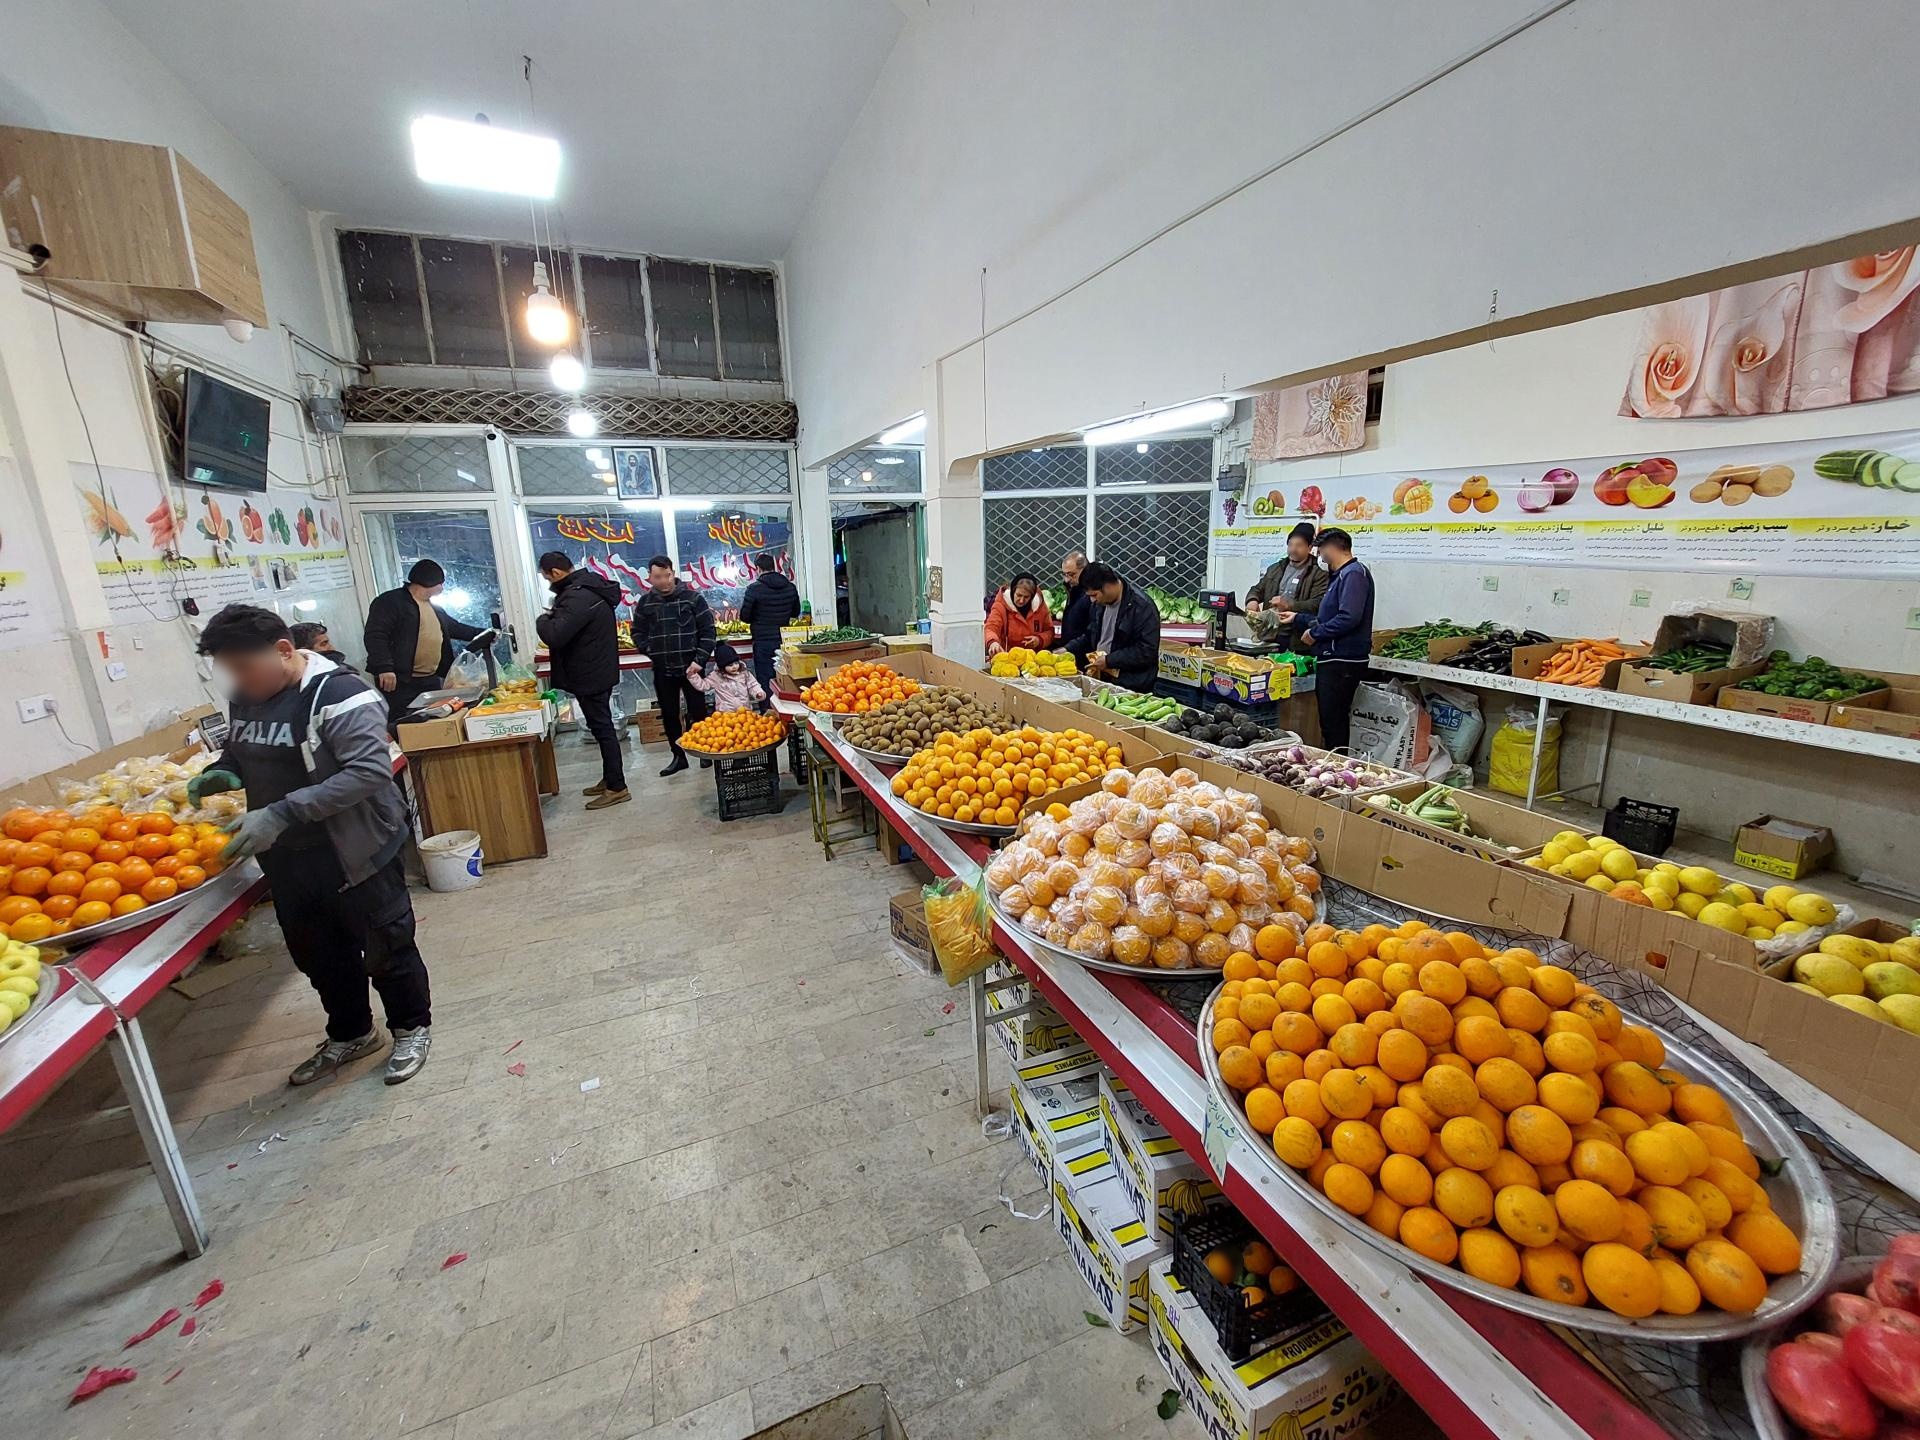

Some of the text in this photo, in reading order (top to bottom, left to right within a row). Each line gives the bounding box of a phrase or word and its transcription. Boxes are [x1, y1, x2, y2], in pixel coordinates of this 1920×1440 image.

[1762, 524, 1789, 533] سیب
[1352, 708, 1399, 728] نیک پلاست
[1282, 1330, 1323, 1360] PRODUCE
[1322, 1326, 1334, 1341] OF
[1329, 1375, 1381, 1417] SOL
